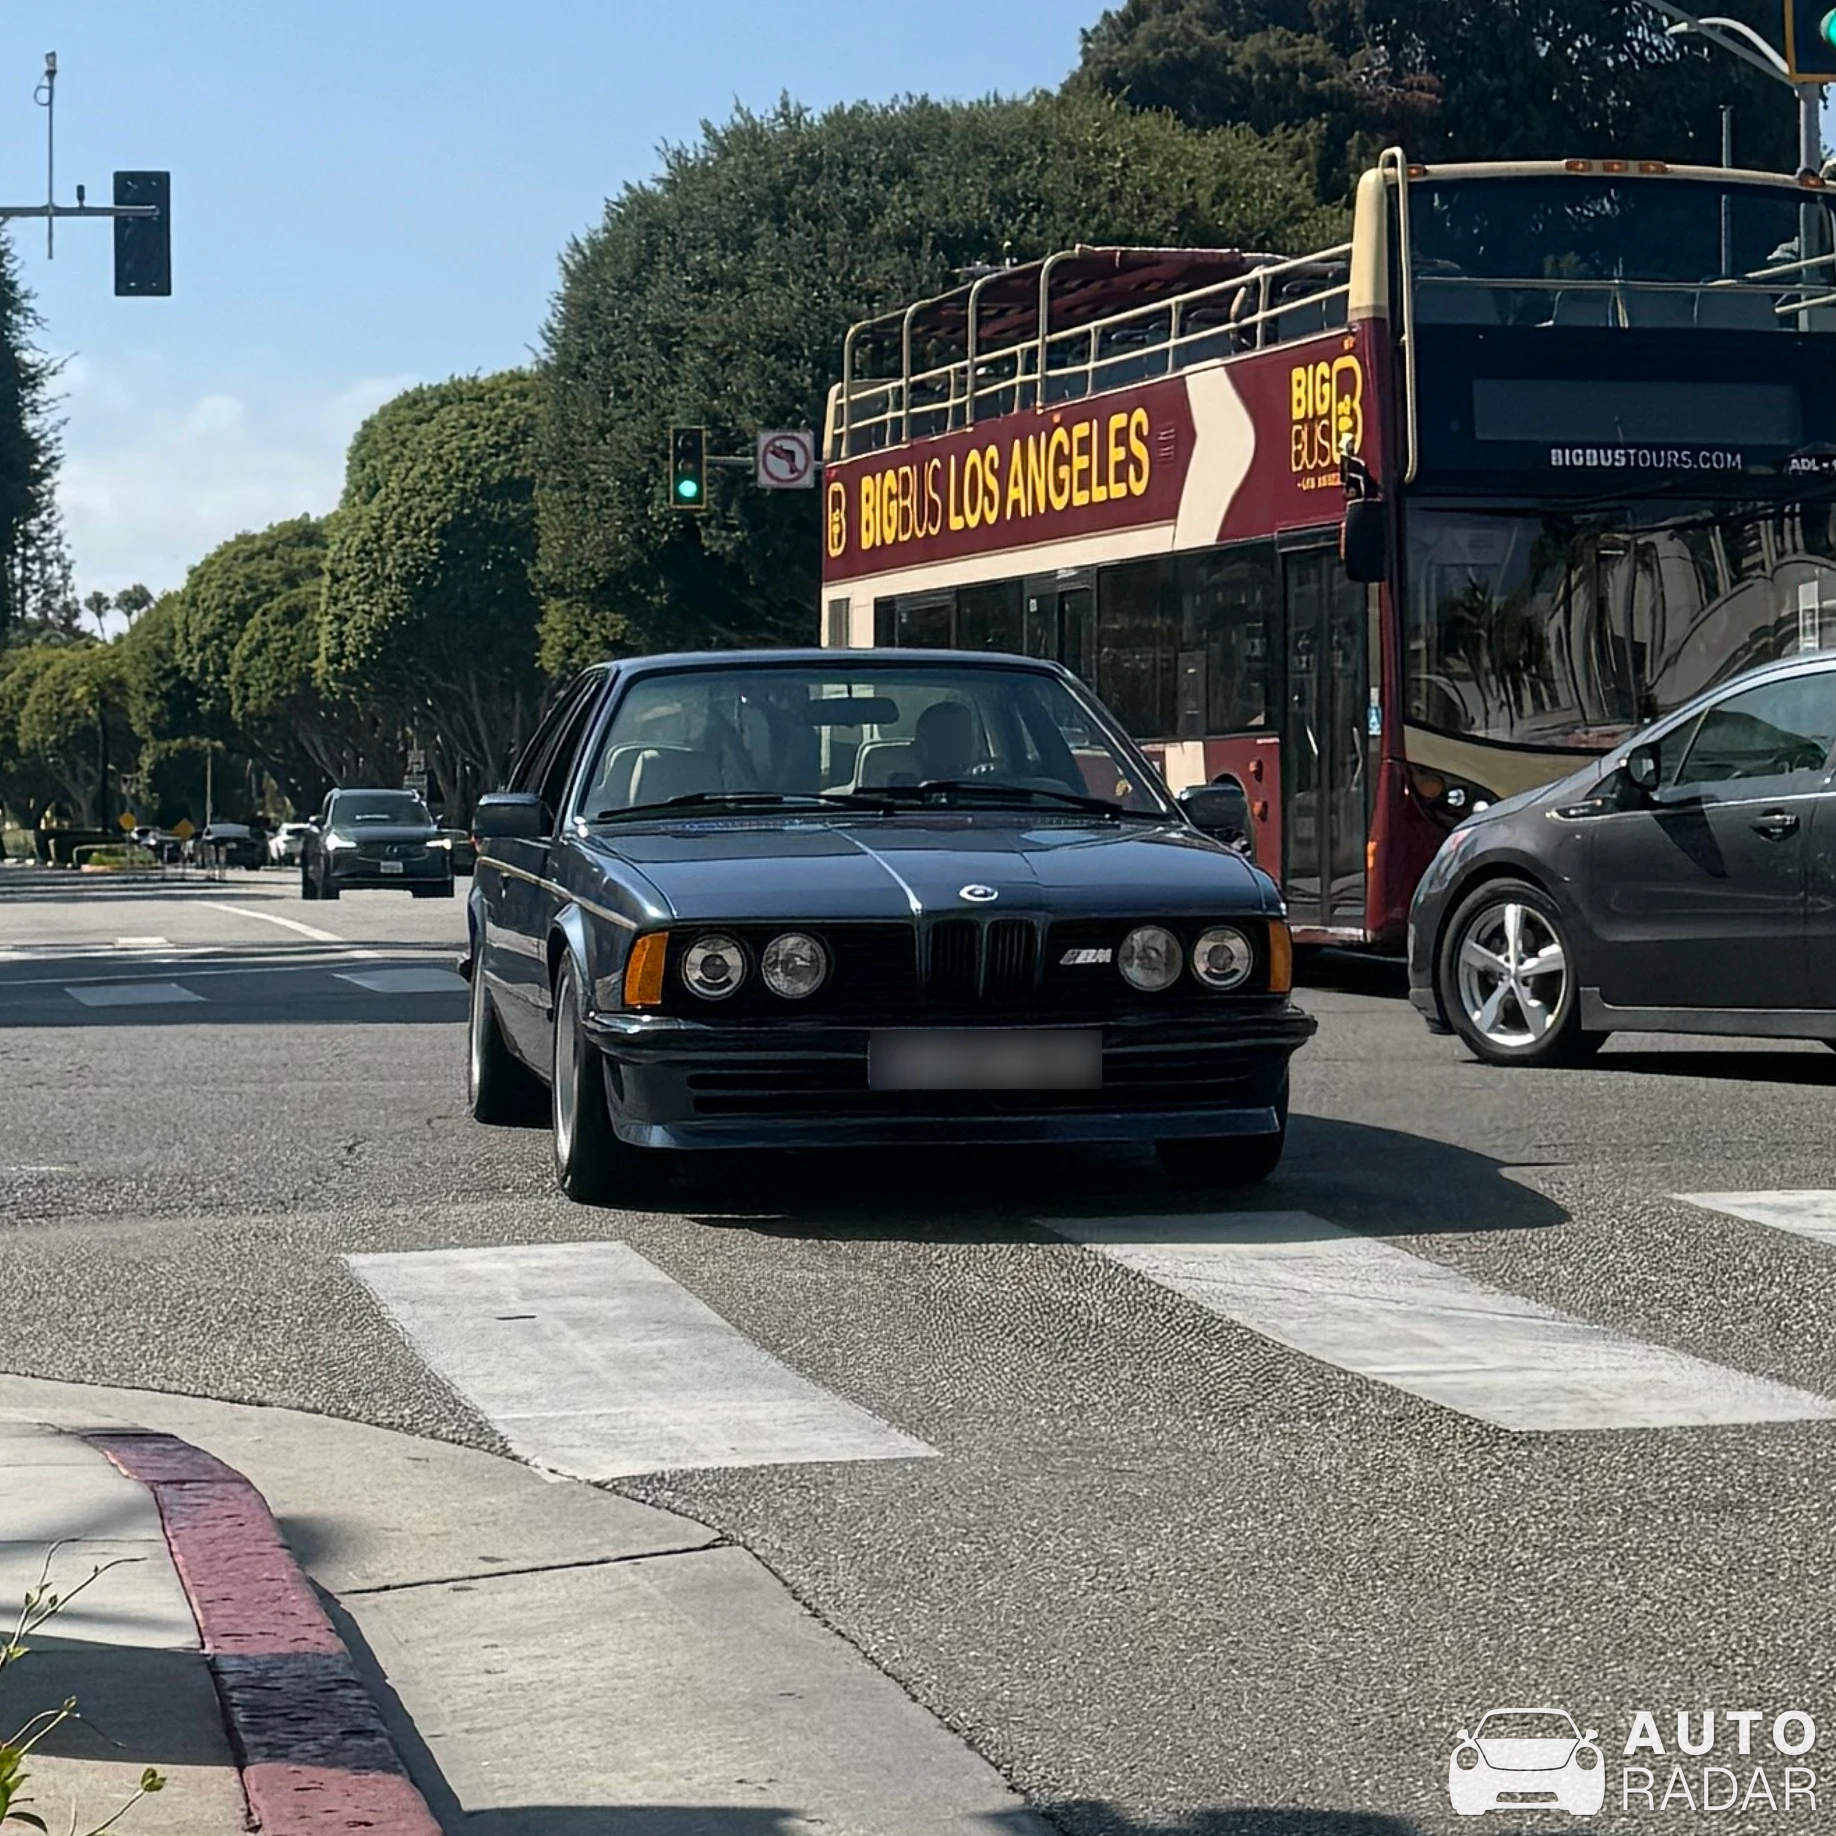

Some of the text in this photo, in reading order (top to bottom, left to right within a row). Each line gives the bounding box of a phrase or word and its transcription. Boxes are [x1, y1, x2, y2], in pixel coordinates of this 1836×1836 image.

[1291, 362, 1330, 420] BIG
[950, 445, 999, 531] LOS
[1006, 407, 1149, 521] ANGELES
[1291, 419, 1331, 472] BUS
[1550, 448, 1742, 470] BIGBUSTOURS.COM
